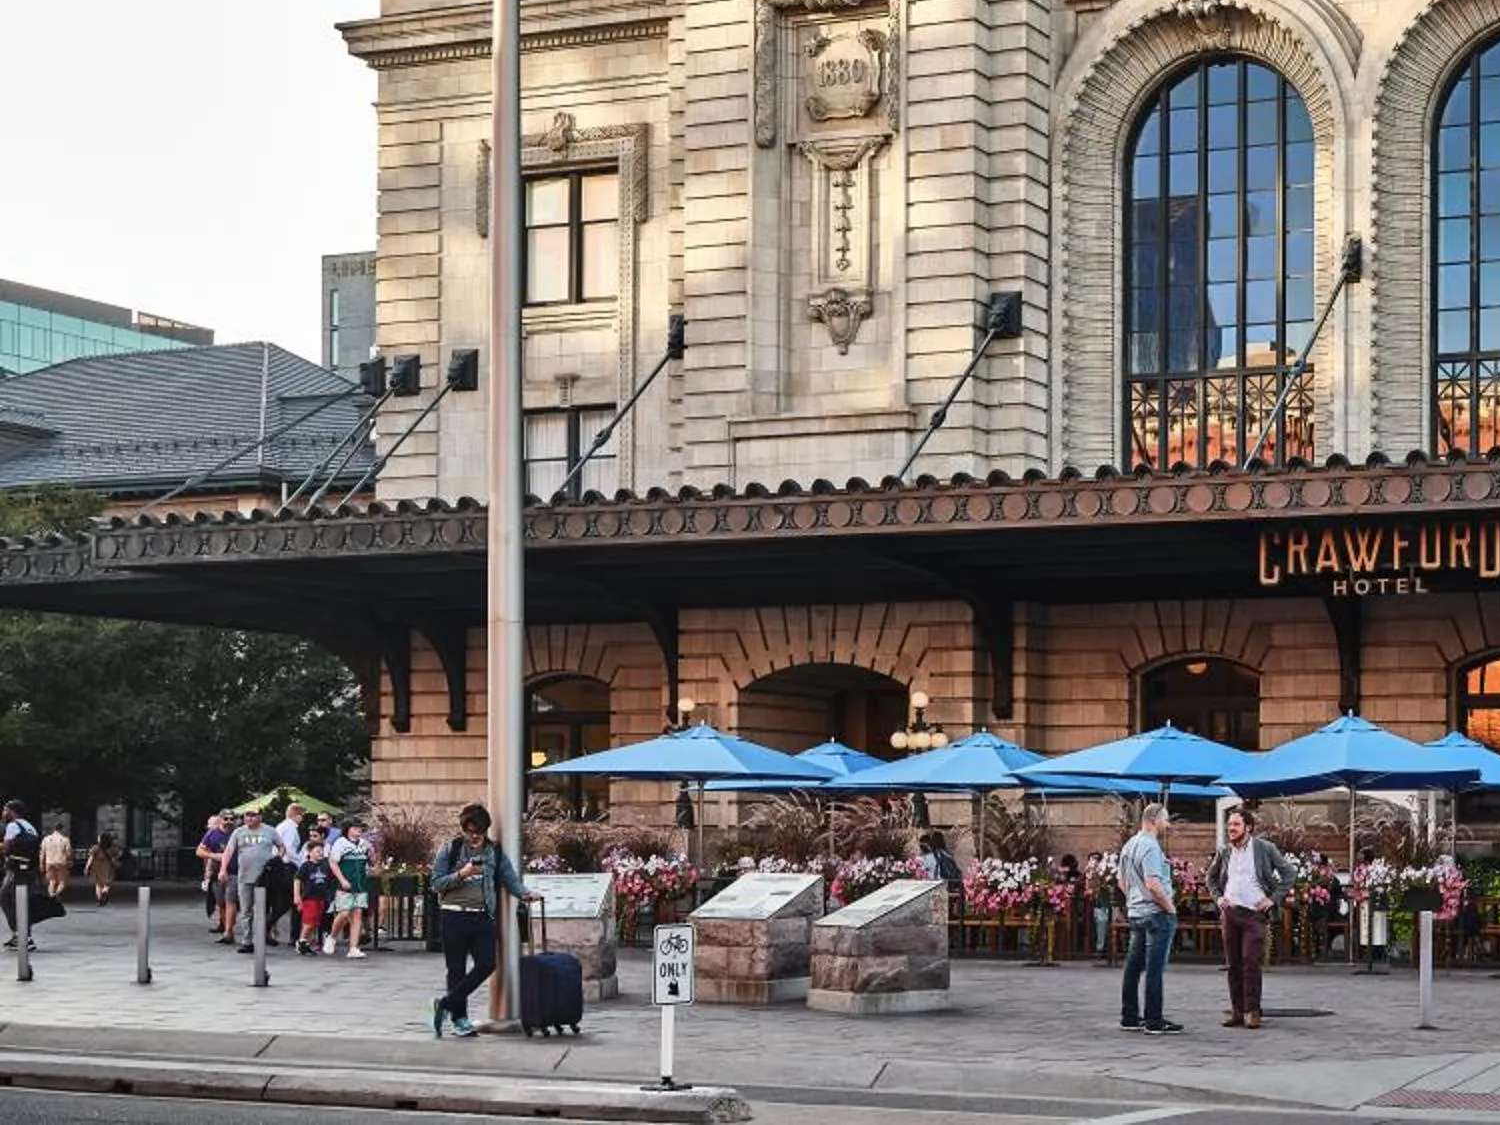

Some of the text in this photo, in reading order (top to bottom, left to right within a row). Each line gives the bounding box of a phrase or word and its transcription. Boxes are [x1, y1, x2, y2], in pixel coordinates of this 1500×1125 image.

[1259, 522, 1500, 586] CRAWFORD
[1333, 577, 1428, 596] HOTEL
[659, 962, 689, 978] ONLY
